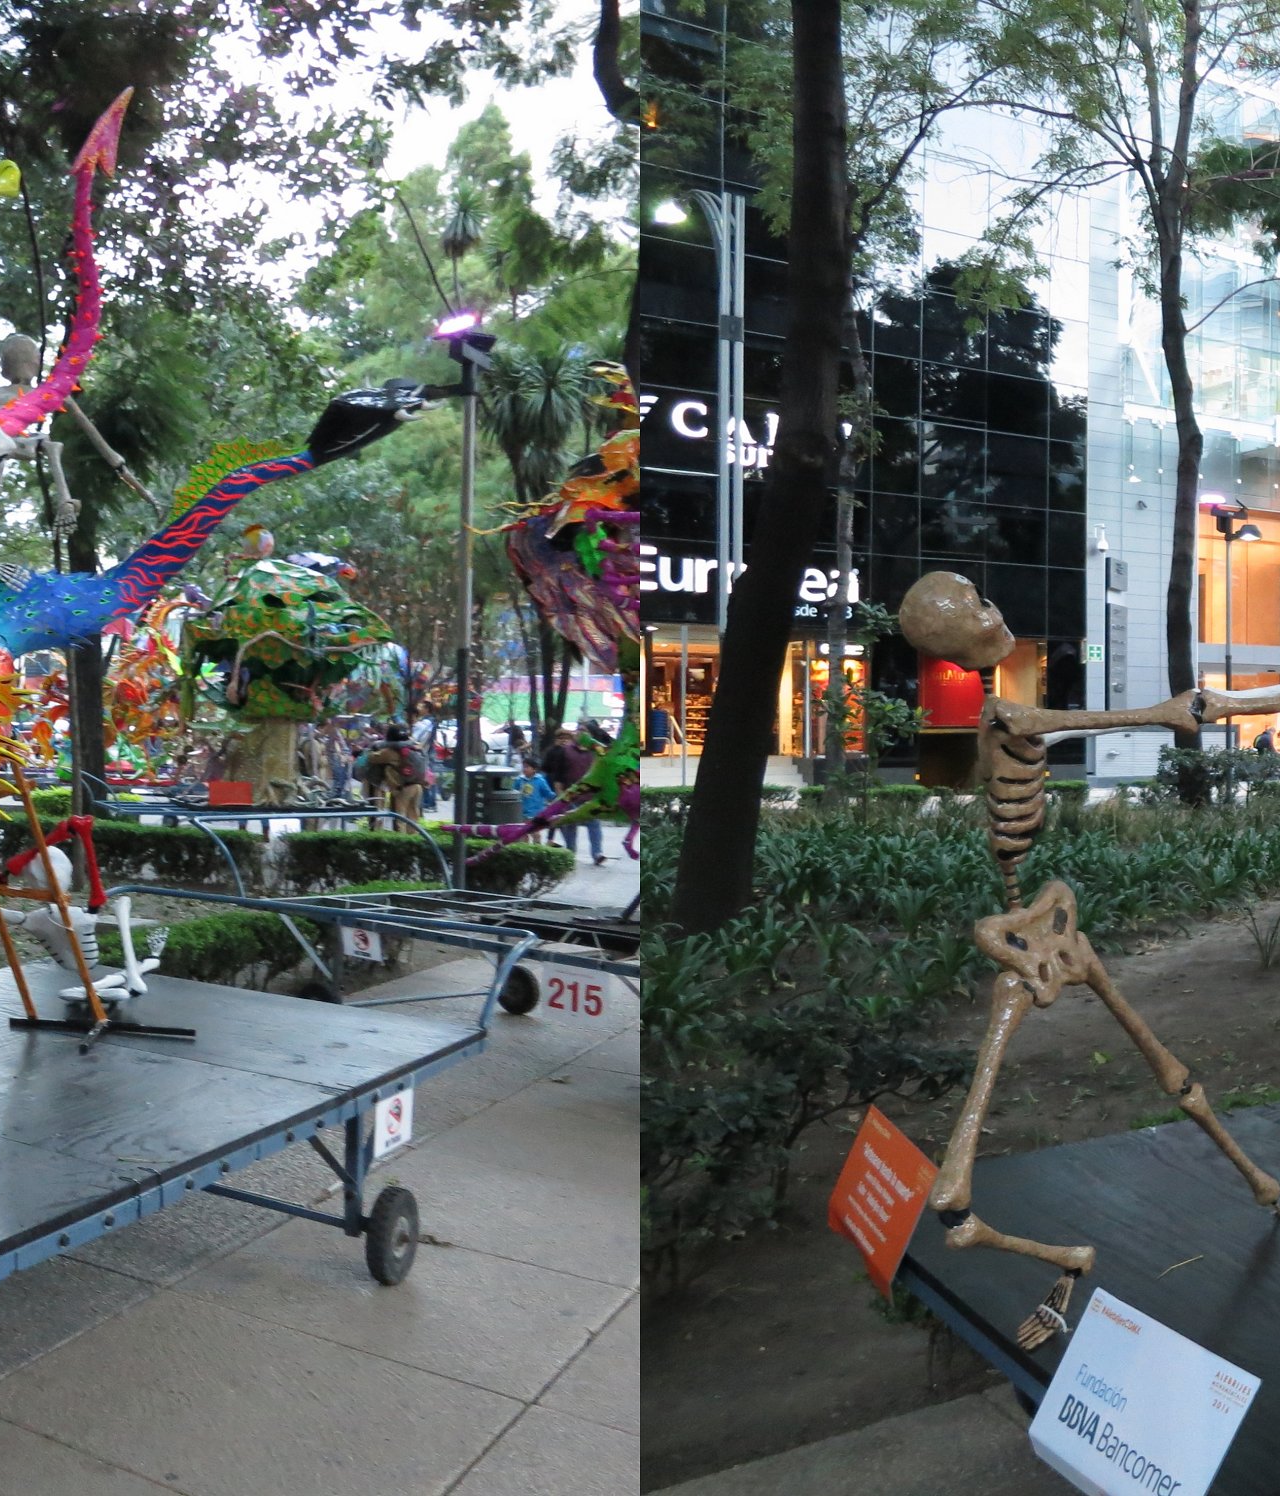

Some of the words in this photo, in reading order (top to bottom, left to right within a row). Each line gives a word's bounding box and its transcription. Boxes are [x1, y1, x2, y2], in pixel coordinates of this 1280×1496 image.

[548, 977, 603, 1017] 215
[1075, 1363, 1128, 1413] Fundación
[1058, 1393, 1100, 1445] BBVA
[1095, 1422, 1182, 1496] Bancomer
